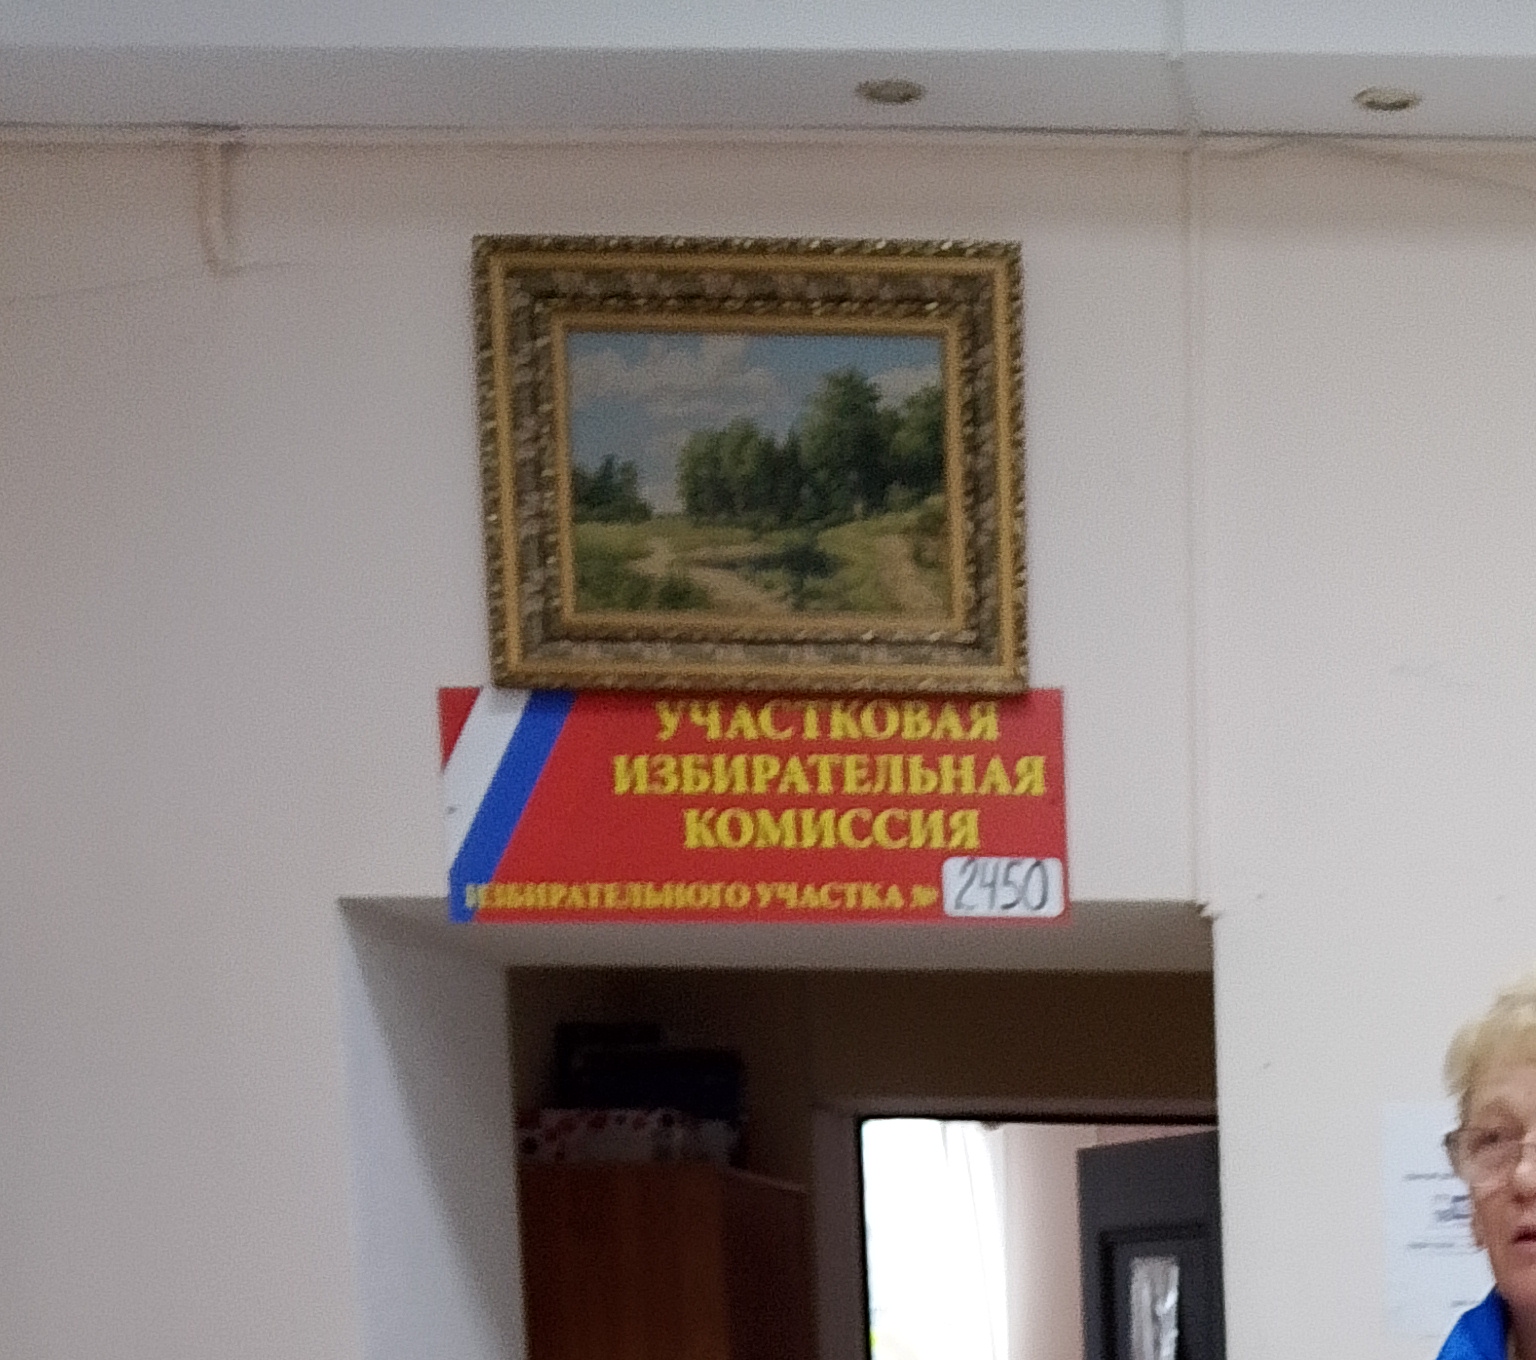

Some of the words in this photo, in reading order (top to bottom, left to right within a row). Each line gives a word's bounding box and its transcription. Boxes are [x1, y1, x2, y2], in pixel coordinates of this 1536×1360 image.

[656, 700, 1000, 742] УЧАСТКОВАЯ
[613, 754, 1047, 797] ИЗБИРАТЕЛЬНАЯ
[683, 806, 981, 850] КОМИССИЯ
[755, 882, 904, 909] УЧАСТКА
[954, 857, 1051, 912] 2450
